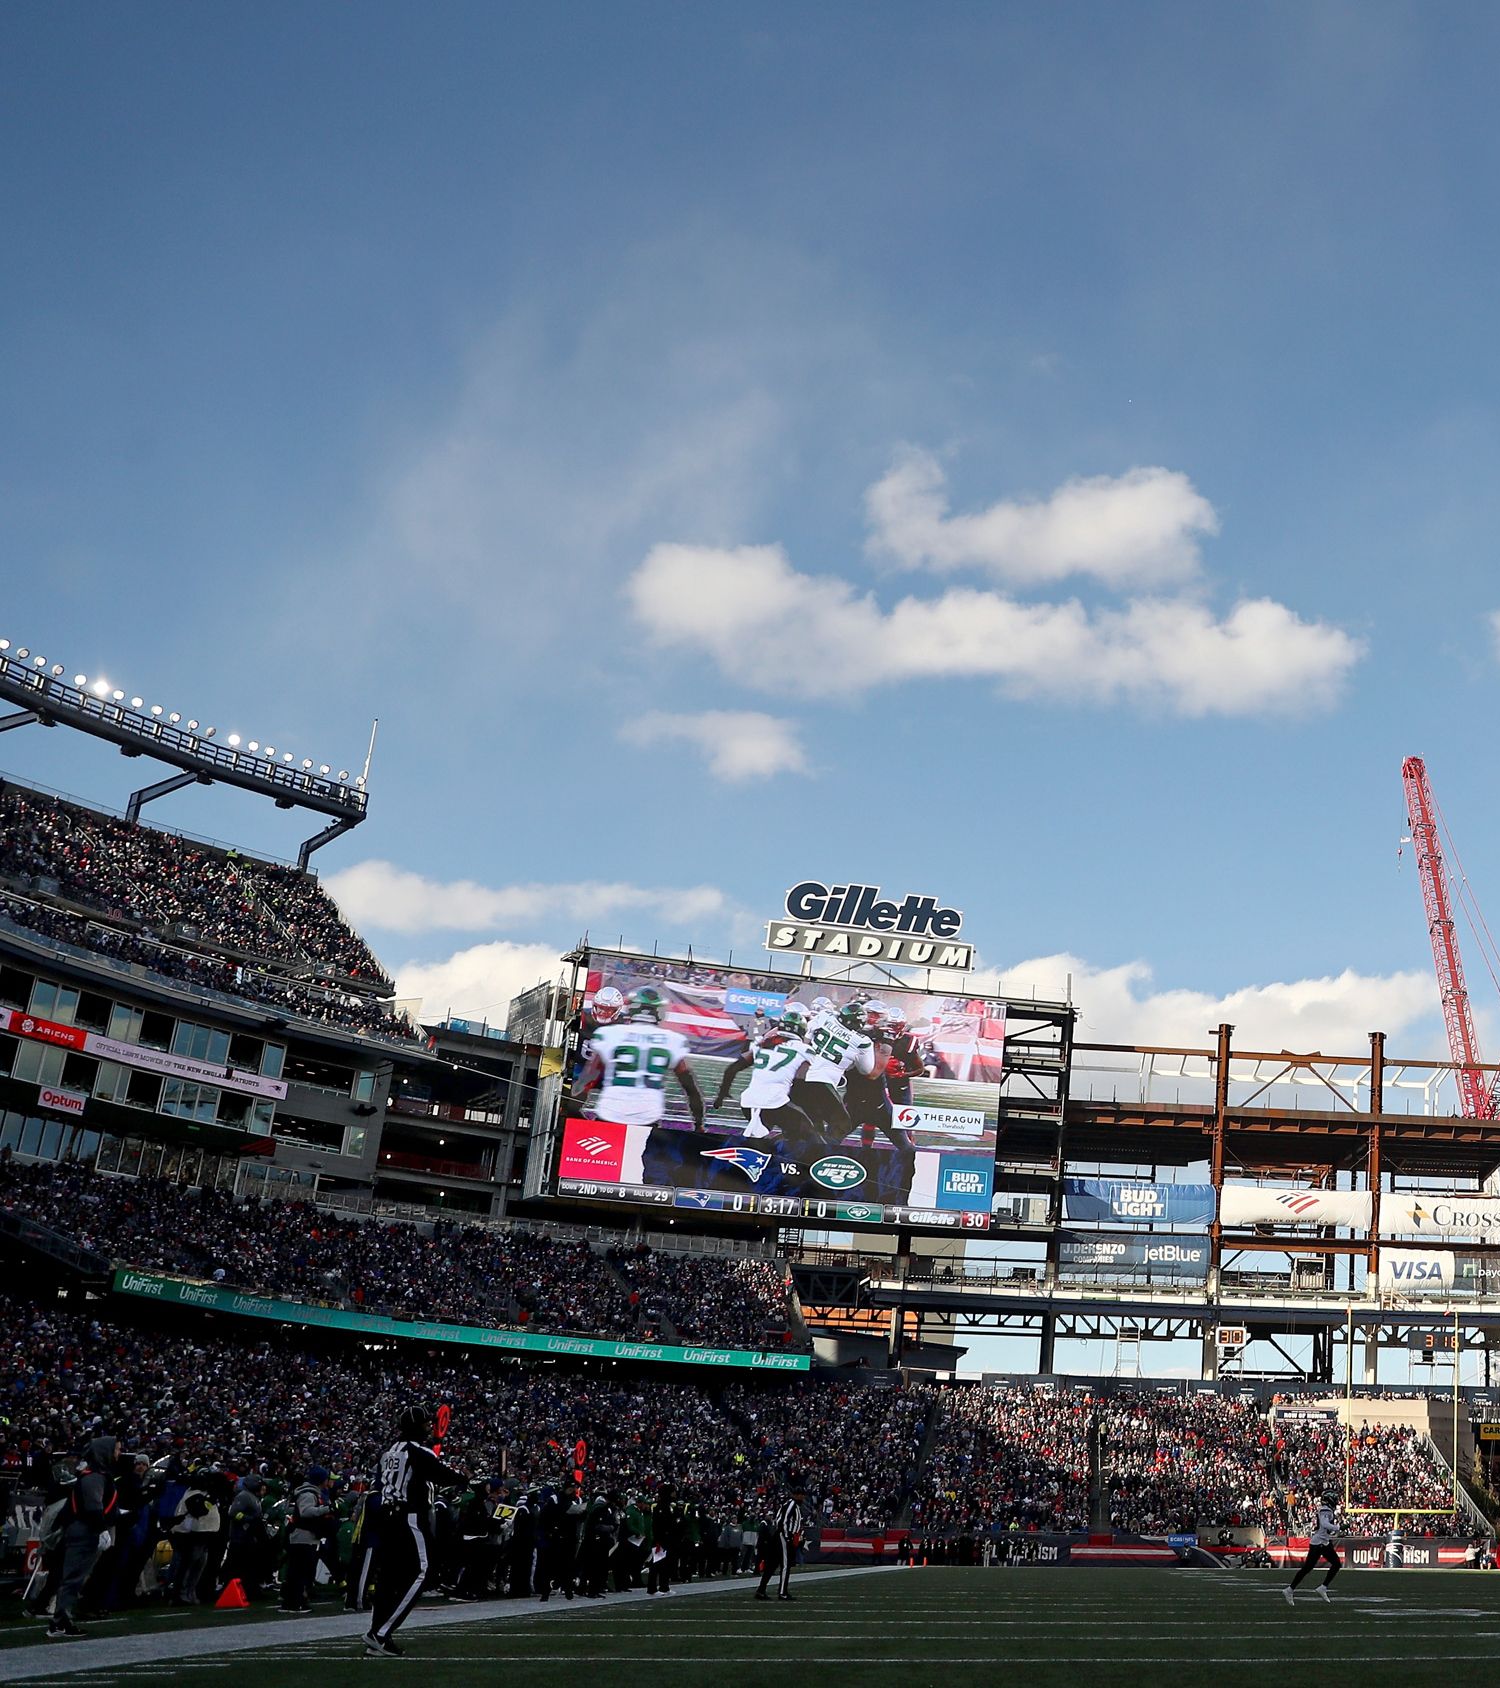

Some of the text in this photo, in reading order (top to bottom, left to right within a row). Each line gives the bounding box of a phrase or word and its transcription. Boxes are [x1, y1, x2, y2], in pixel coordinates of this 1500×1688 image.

[787, 882, 961, 937] Gillette
[773, 928, 968, 967] STADIUM
[740, 995, 781, 1008] CBS NFL
[36, 1026, 76, 1041] ARIENS
[823, 1021, 852, 1042] WILLIAMS
[813, 1027, 850, 1065] 95
[95, 1042, 121, 1056] OFFICIAL
[140, 1054, 163, 1066] MOWER
[173, 1062, 186, 1071] THE
[187, 1066, 201, 1075] NEW
[612, 1046, 671, 1089] 29
[43, 1091, 82, 1109] Optum
[924, 1113, 980, 1124] THERAGUN
[817, 1167, 860, 1179] JETS
[951, 1172, 980, 1184] BUD
[578, 1183, 598, 1196] 2ND
[618, 1187, 626, 1198] 8
[654, 1190, 669, 1202] 29
[945, 1182, 984, 1194] LIGHT
[1120, 1189, 1157, 1203] BUD
[733, 1195, 742, 1211] 0
[764, 1198, 795, 1215] 3:17
[817, 1202, 827, 1218] 0
[1112, 1202, 1164, 1216] LIGHT
[909, 1211, 955, 1225] Gillette
[966, 1213, 984, 1227] 30
[1143, 1244, 1201, 1264] jetBlue
[1387, 1261, 1443, 1280] VISA
[121, 1275, 164, 1295] UniFirst
[179, 1286, 218, 1304] UniFirst
[232, 1296, 273, 1314] UniFirst
[480, 1330, 527, 1347] UniFirst
[1221, 1330, 1242, 1343] 30
[547, 1338, 594, 1354] UniFirst
[614, 1344, 663, 1359] UniFirst
[683, 1350, 730, 1364] UniFirst
[752, 1354, 800, 1368] UniFirst
[384, 1458, 400, 1470] 103
